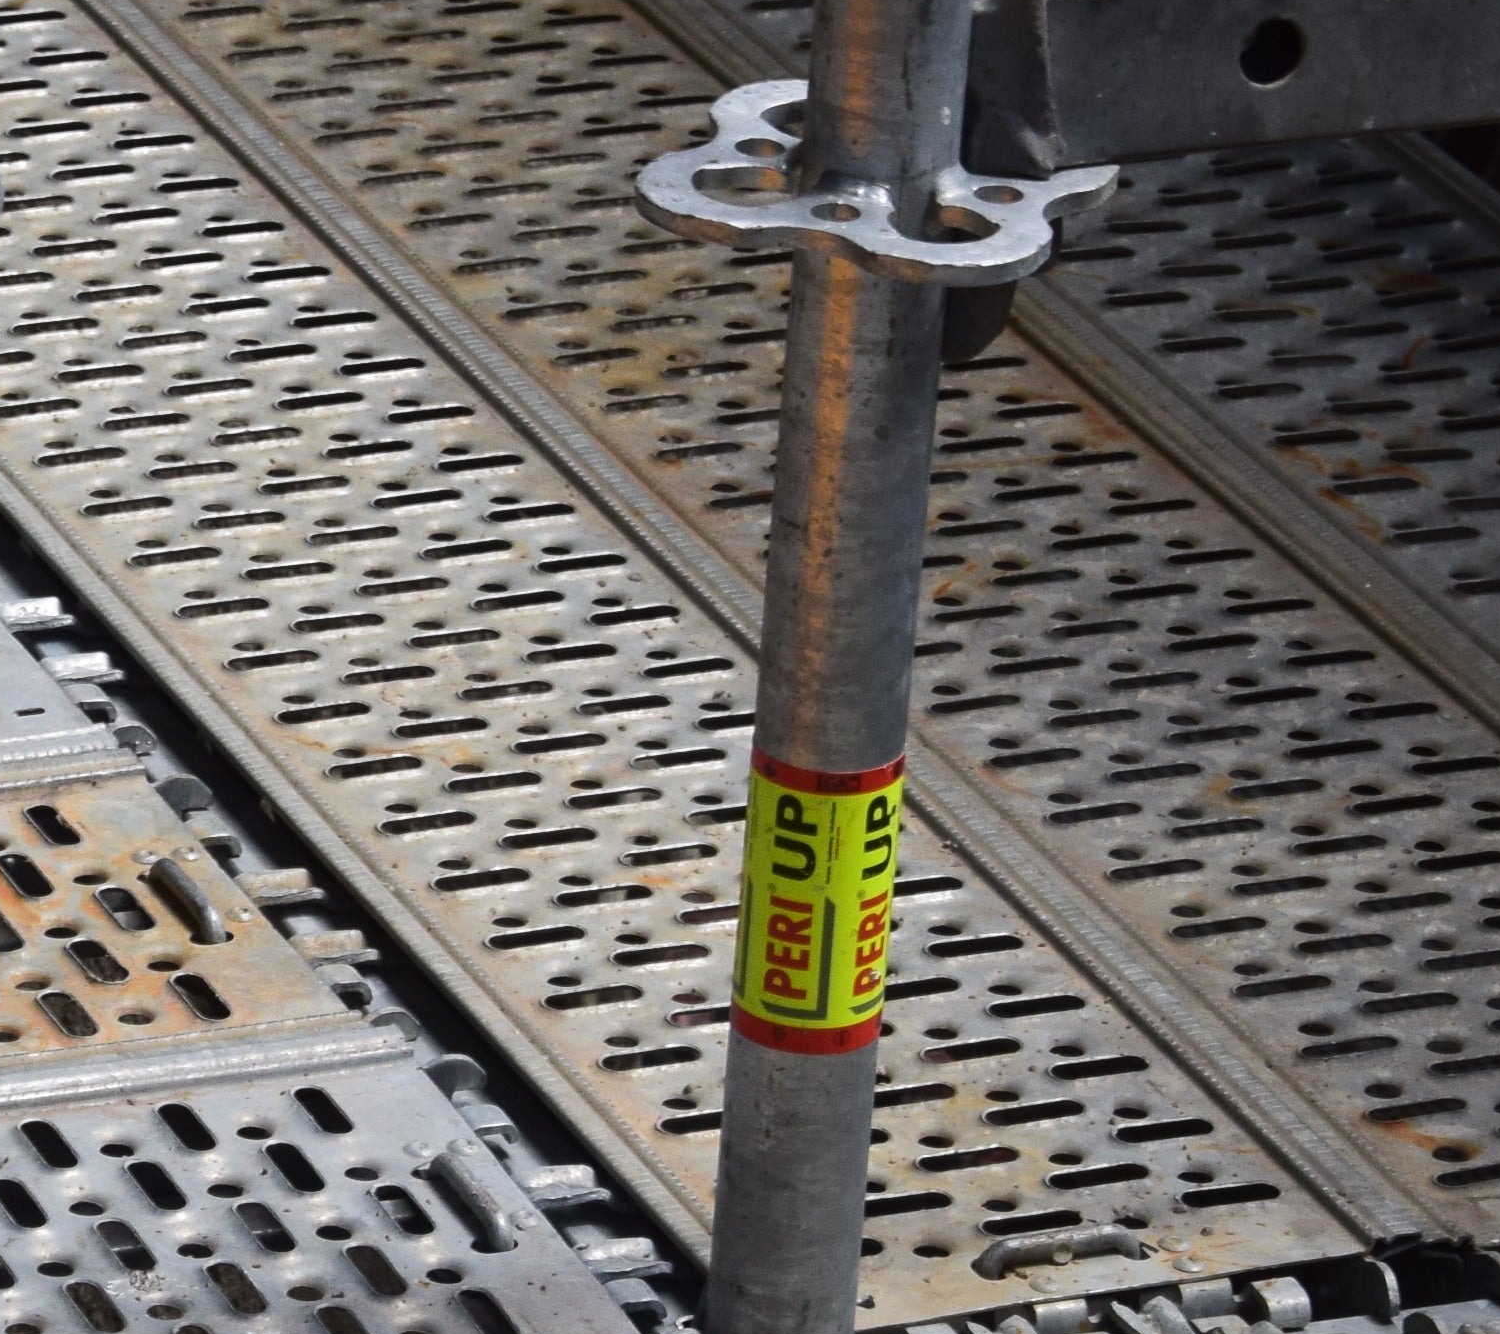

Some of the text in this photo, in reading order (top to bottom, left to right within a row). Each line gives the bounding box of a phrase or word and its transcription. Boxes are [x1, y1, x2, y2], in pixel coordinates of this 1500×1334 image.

[763, 794, 818, 1000] PERI UP
[852, 794, 897, 997] PERI UP
